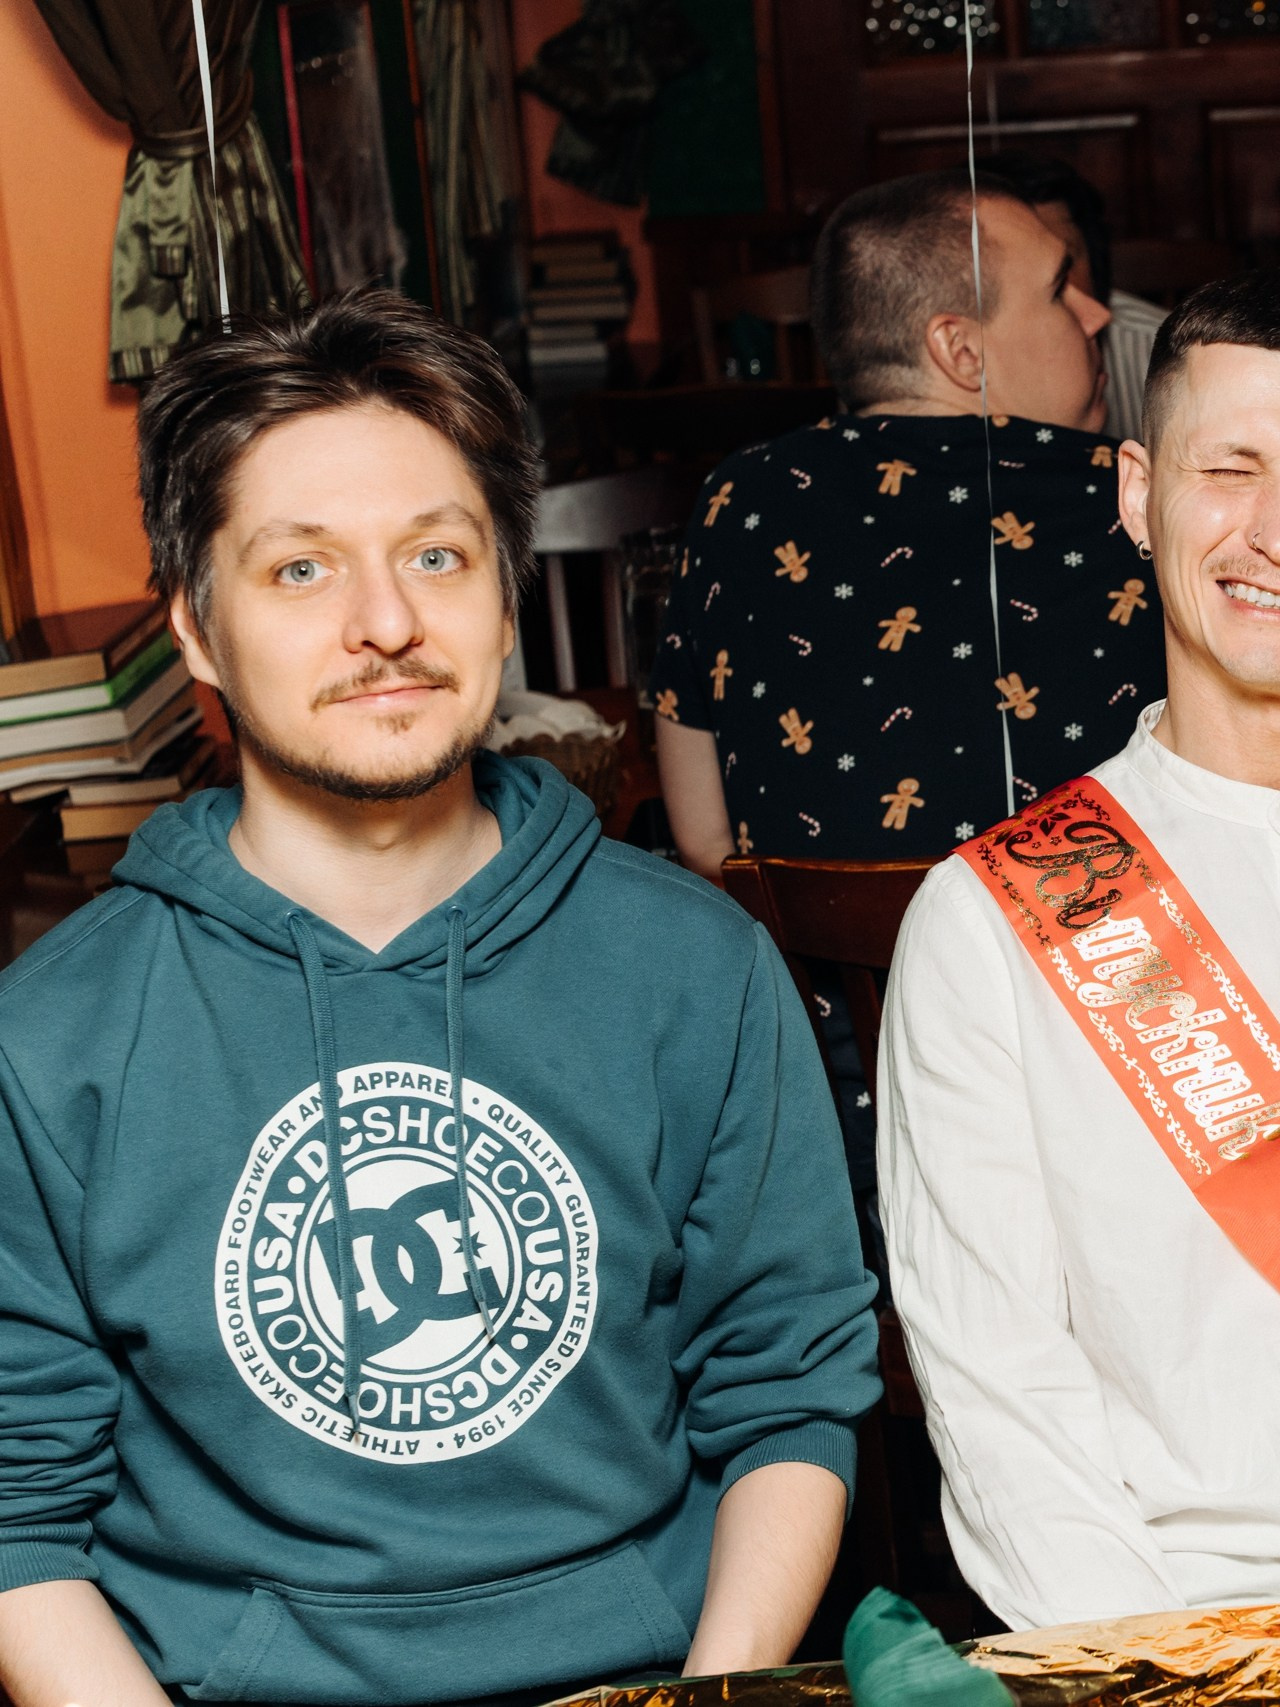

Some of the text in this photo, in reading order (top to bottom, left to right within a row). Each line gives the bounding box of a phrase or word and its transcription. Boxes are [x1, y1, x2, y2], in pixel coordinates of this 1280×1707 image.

[353, 1070, 453, 1099] APPARE
[227, 1118, 297, 1250] FOOTWEAR
[224, 1259, 298, 1409] SKATEBOARD
[453, 1104, 591, 1449] QUALITY GUARANTEED SINCE 1994
[301, 1406, 420, 1456] ATHLETIC
